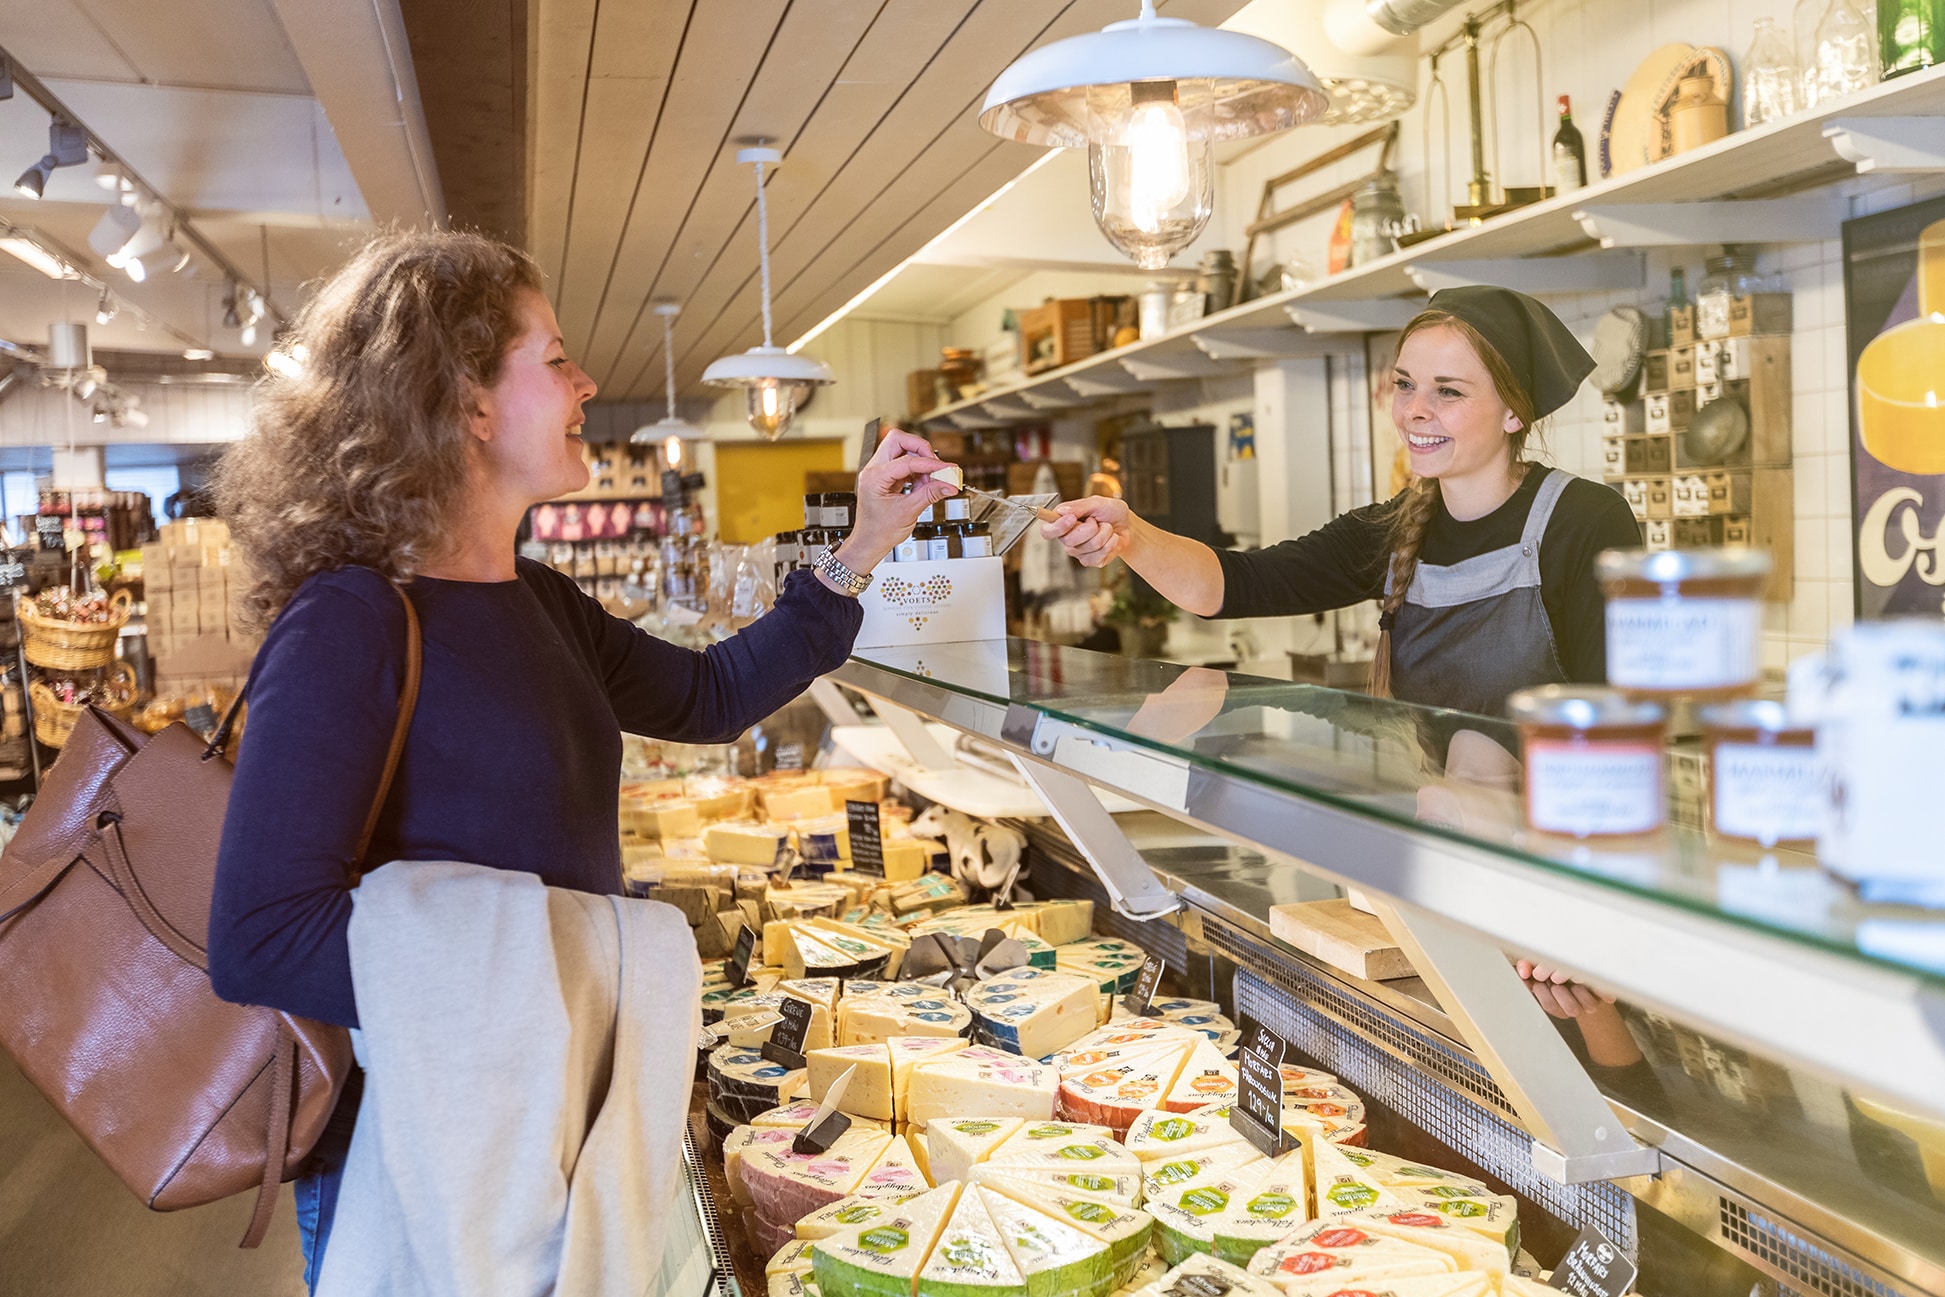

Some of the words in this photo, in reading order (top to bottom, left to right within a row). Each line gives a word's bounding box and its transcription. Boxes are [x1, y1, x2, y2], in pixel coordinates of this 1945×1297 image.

[1188, 1091, 1237, 1099] Falbygdens
[863, 1183, 916, 1192] Falbygdens
[1337, 1192, 1371, 1202] Morfars
[840, 1245, 896, 1265] Falbygdens
[1577, 1240, 1609, 1279] MORFARS
